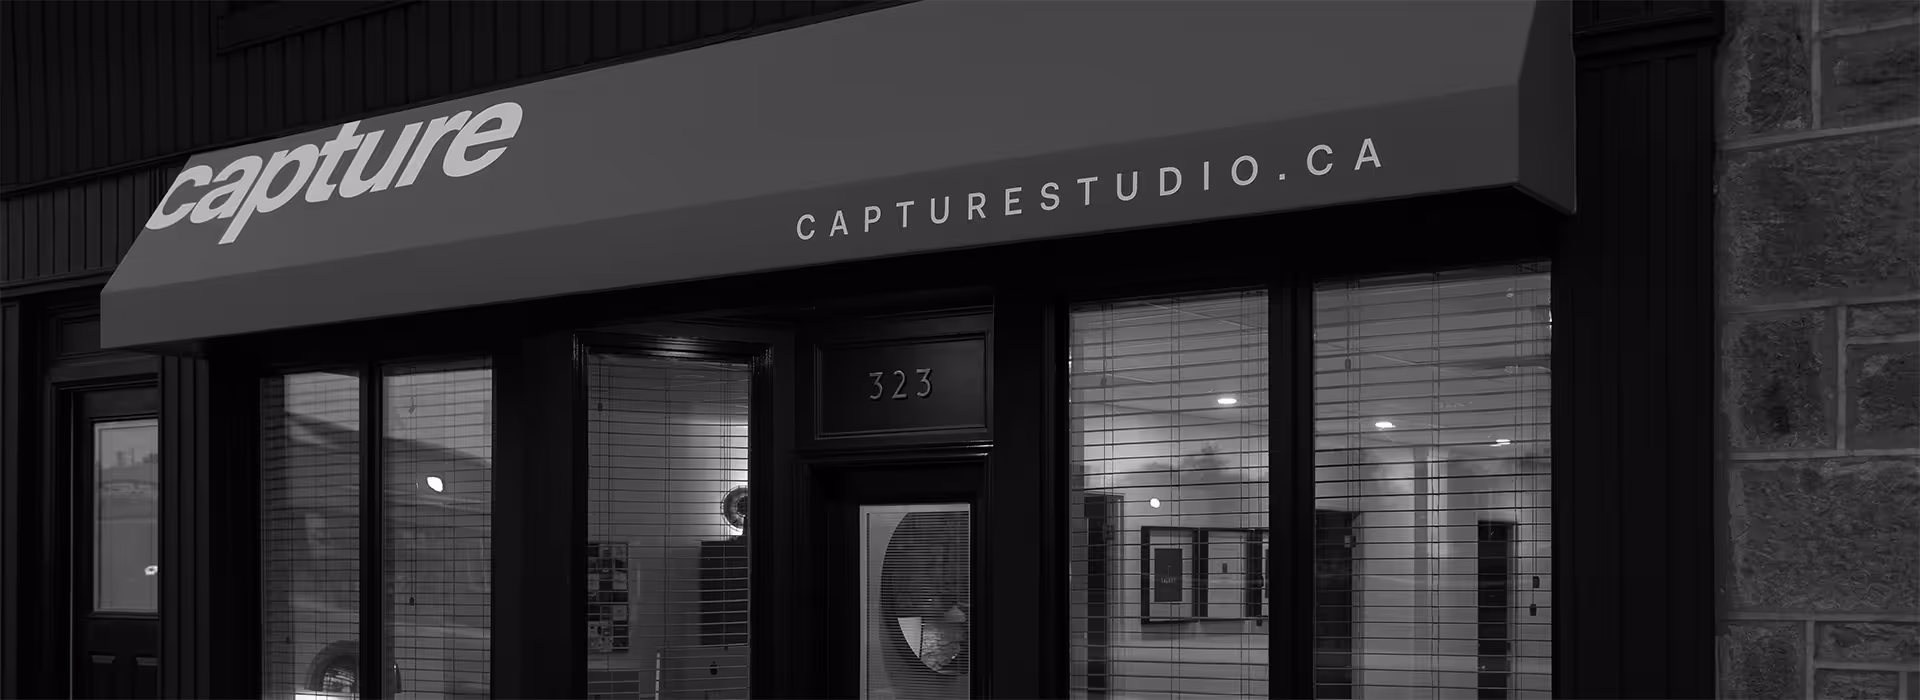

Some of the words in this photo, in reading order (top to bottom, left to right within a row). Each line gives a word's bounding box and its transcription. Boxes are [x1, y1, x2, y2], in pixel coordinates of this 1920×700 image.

[145, 102, 523, 245] capture
[796, 138, 1382, 241] CAPTURESTUDIO.CA
[868, 368, 933, 400] 323
